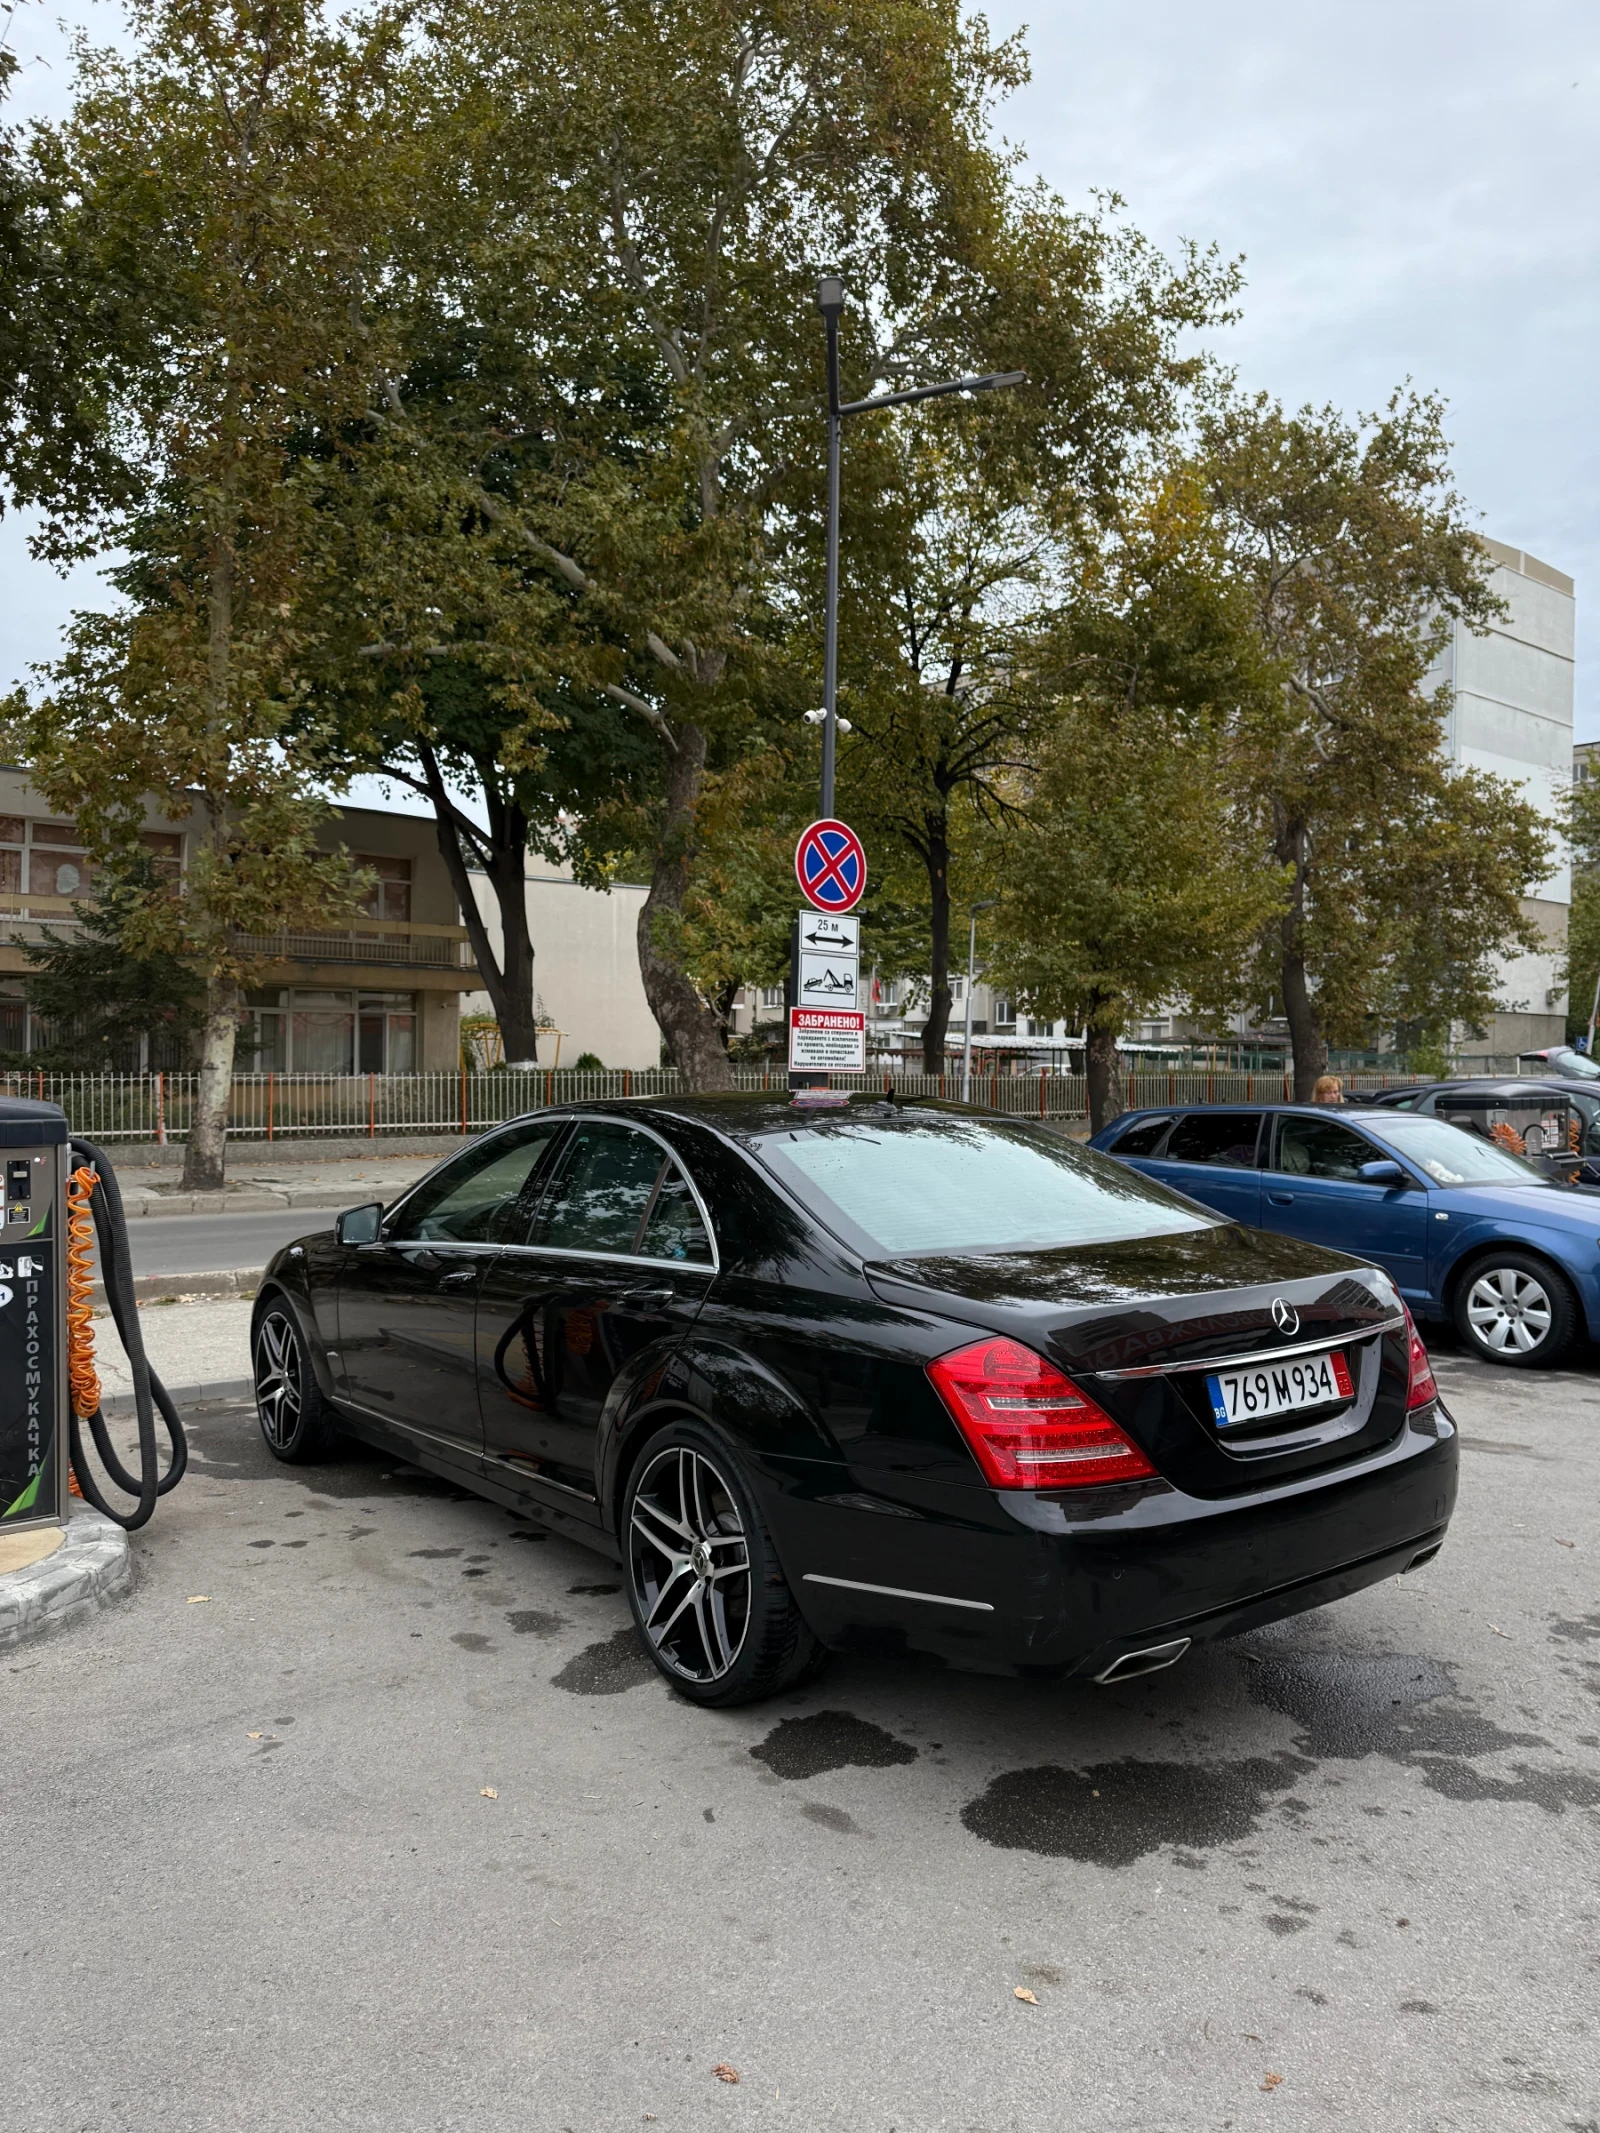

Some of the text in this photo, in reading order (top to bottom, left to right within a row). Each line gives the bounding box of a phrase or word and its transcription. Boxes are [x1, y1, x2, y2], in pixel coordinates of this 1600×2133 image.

[818, 919, 829, 931] 25
[798, 1014, 860, 1029] ЗАБРАНЕНО!
[26, 1280, 42, 1477] ПРАХОСМУКАЧКА
[1214, 1406, 1226, 1420] BG
